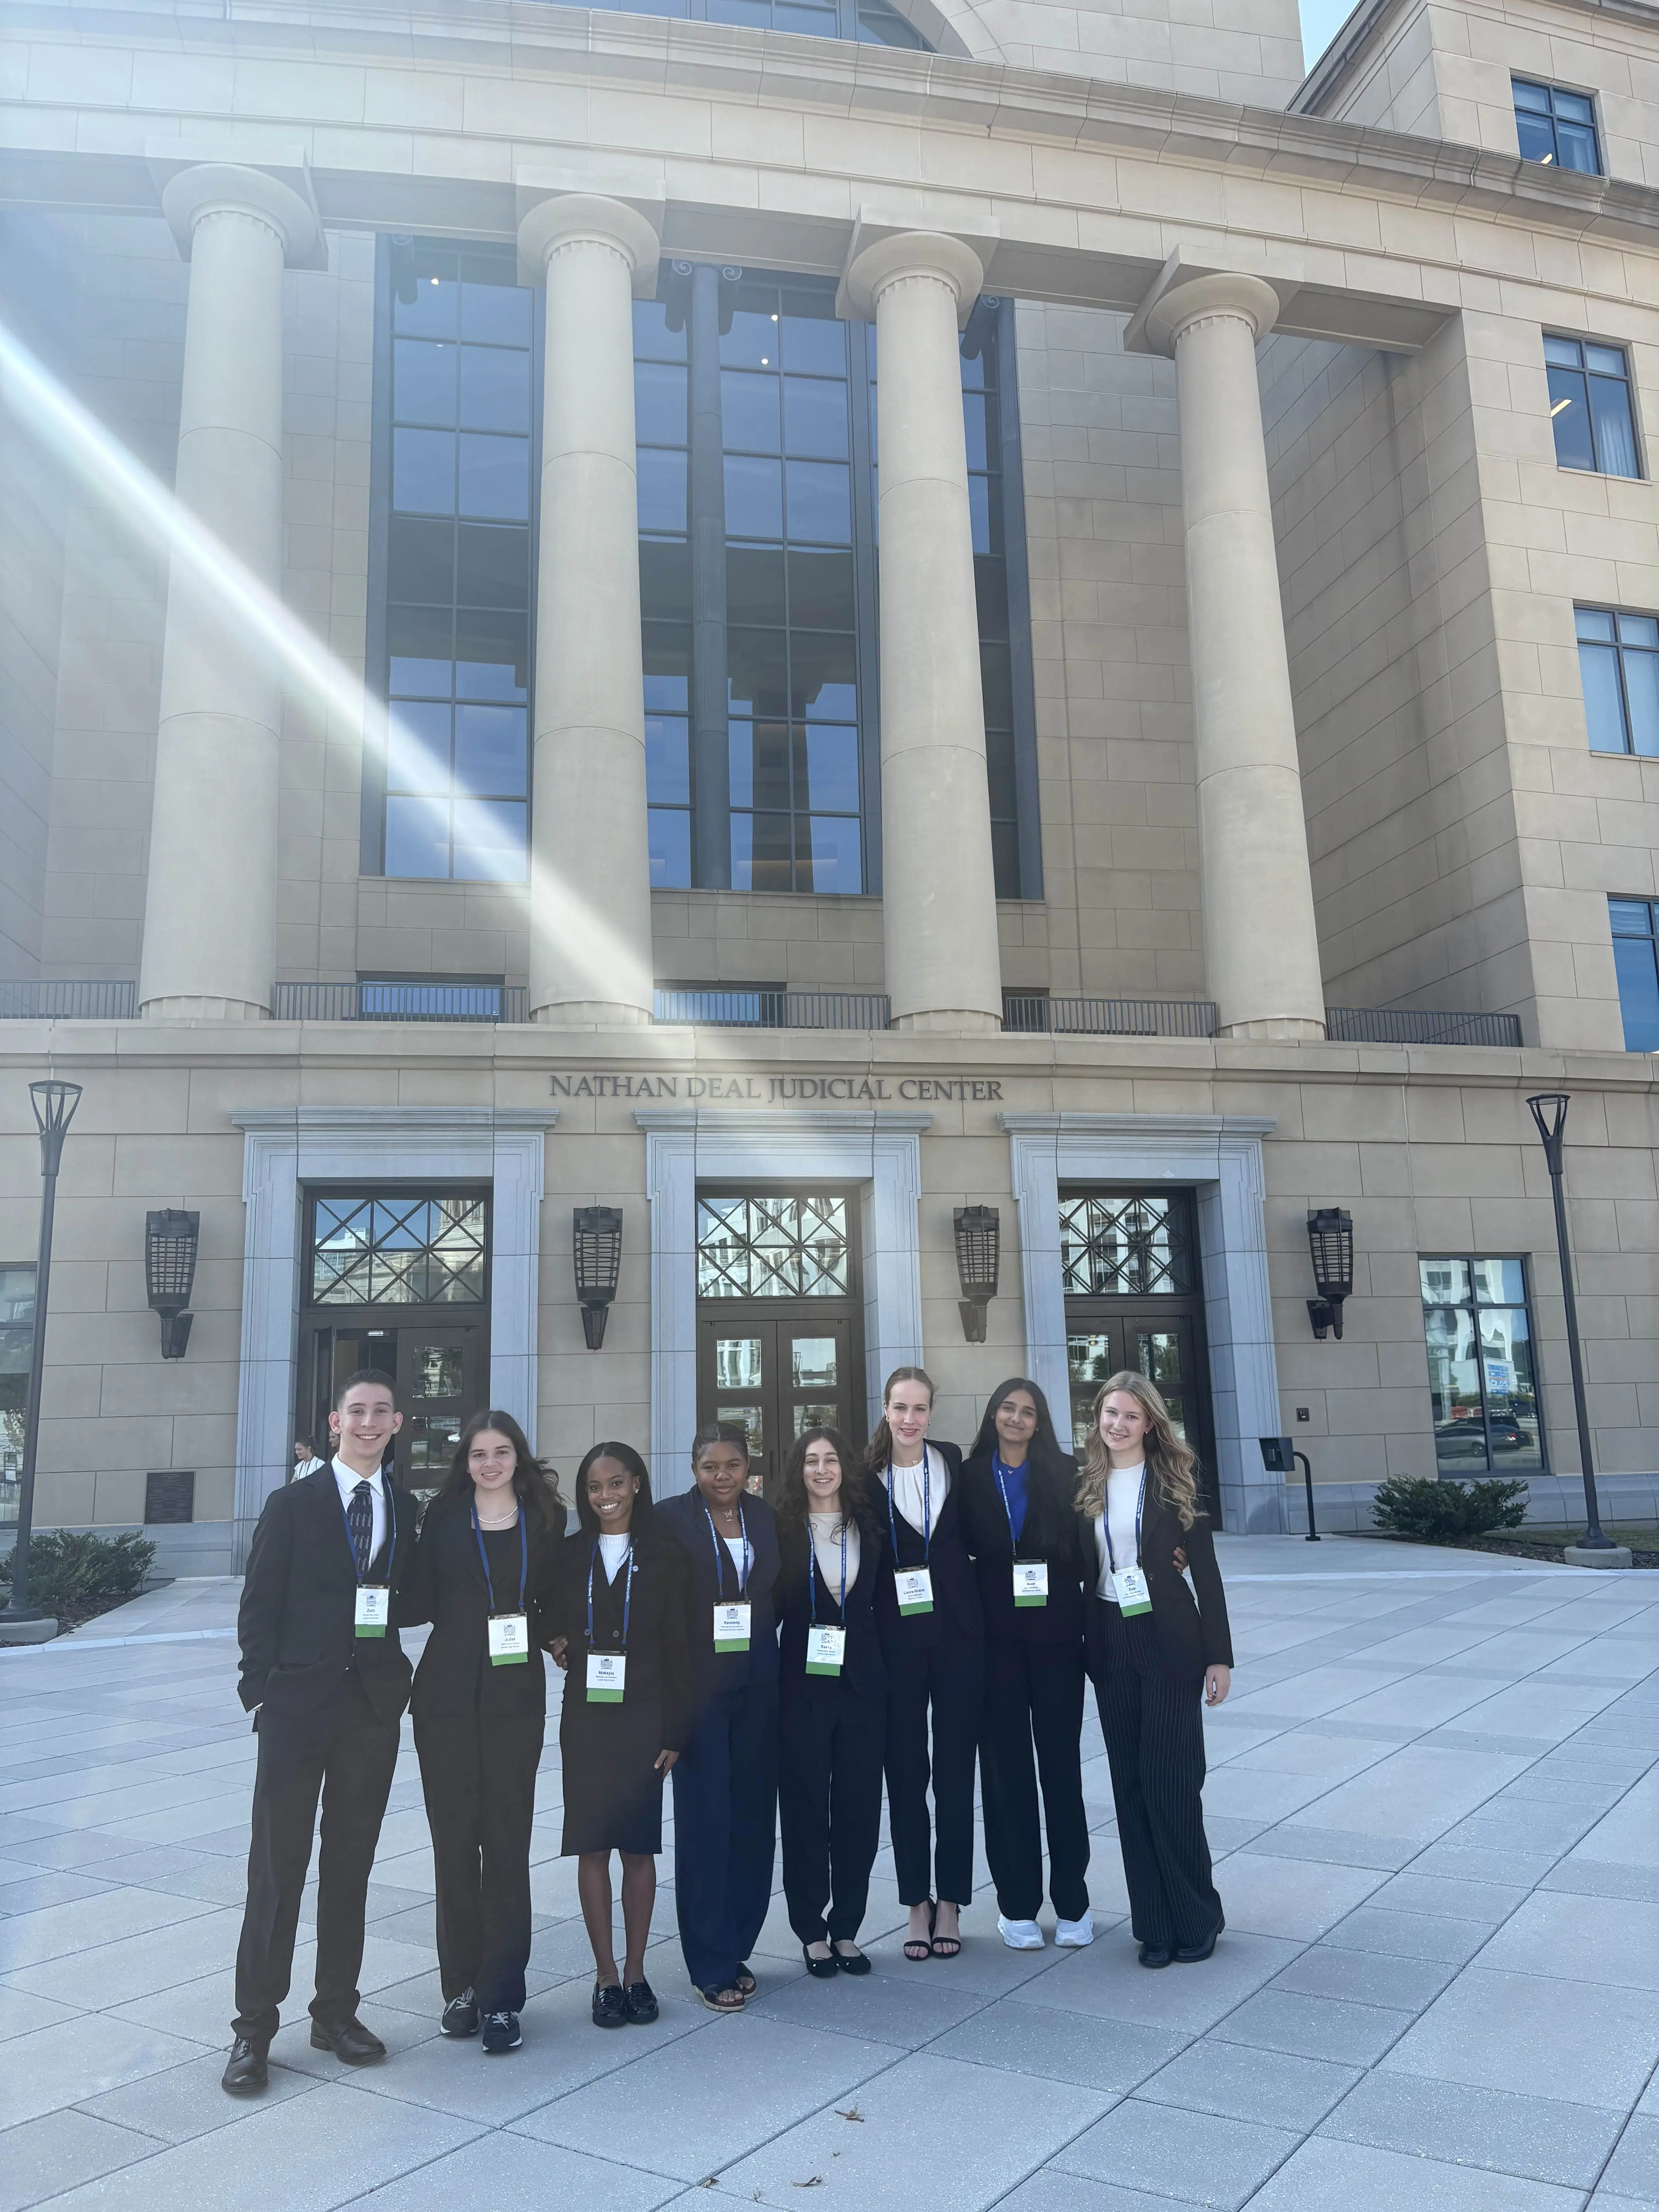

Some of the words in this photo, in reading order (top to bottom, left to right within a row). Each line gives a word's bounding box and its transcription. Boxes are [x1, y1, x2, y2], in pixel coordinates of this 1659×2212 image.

[550, 1075, 678, 1097] NATHAN
[685, 1077, 761, 1098] DEAL
[768, 1079, 892, 1103] JUDICIAL
[899, 1080, 1004, 1101] CENTER
